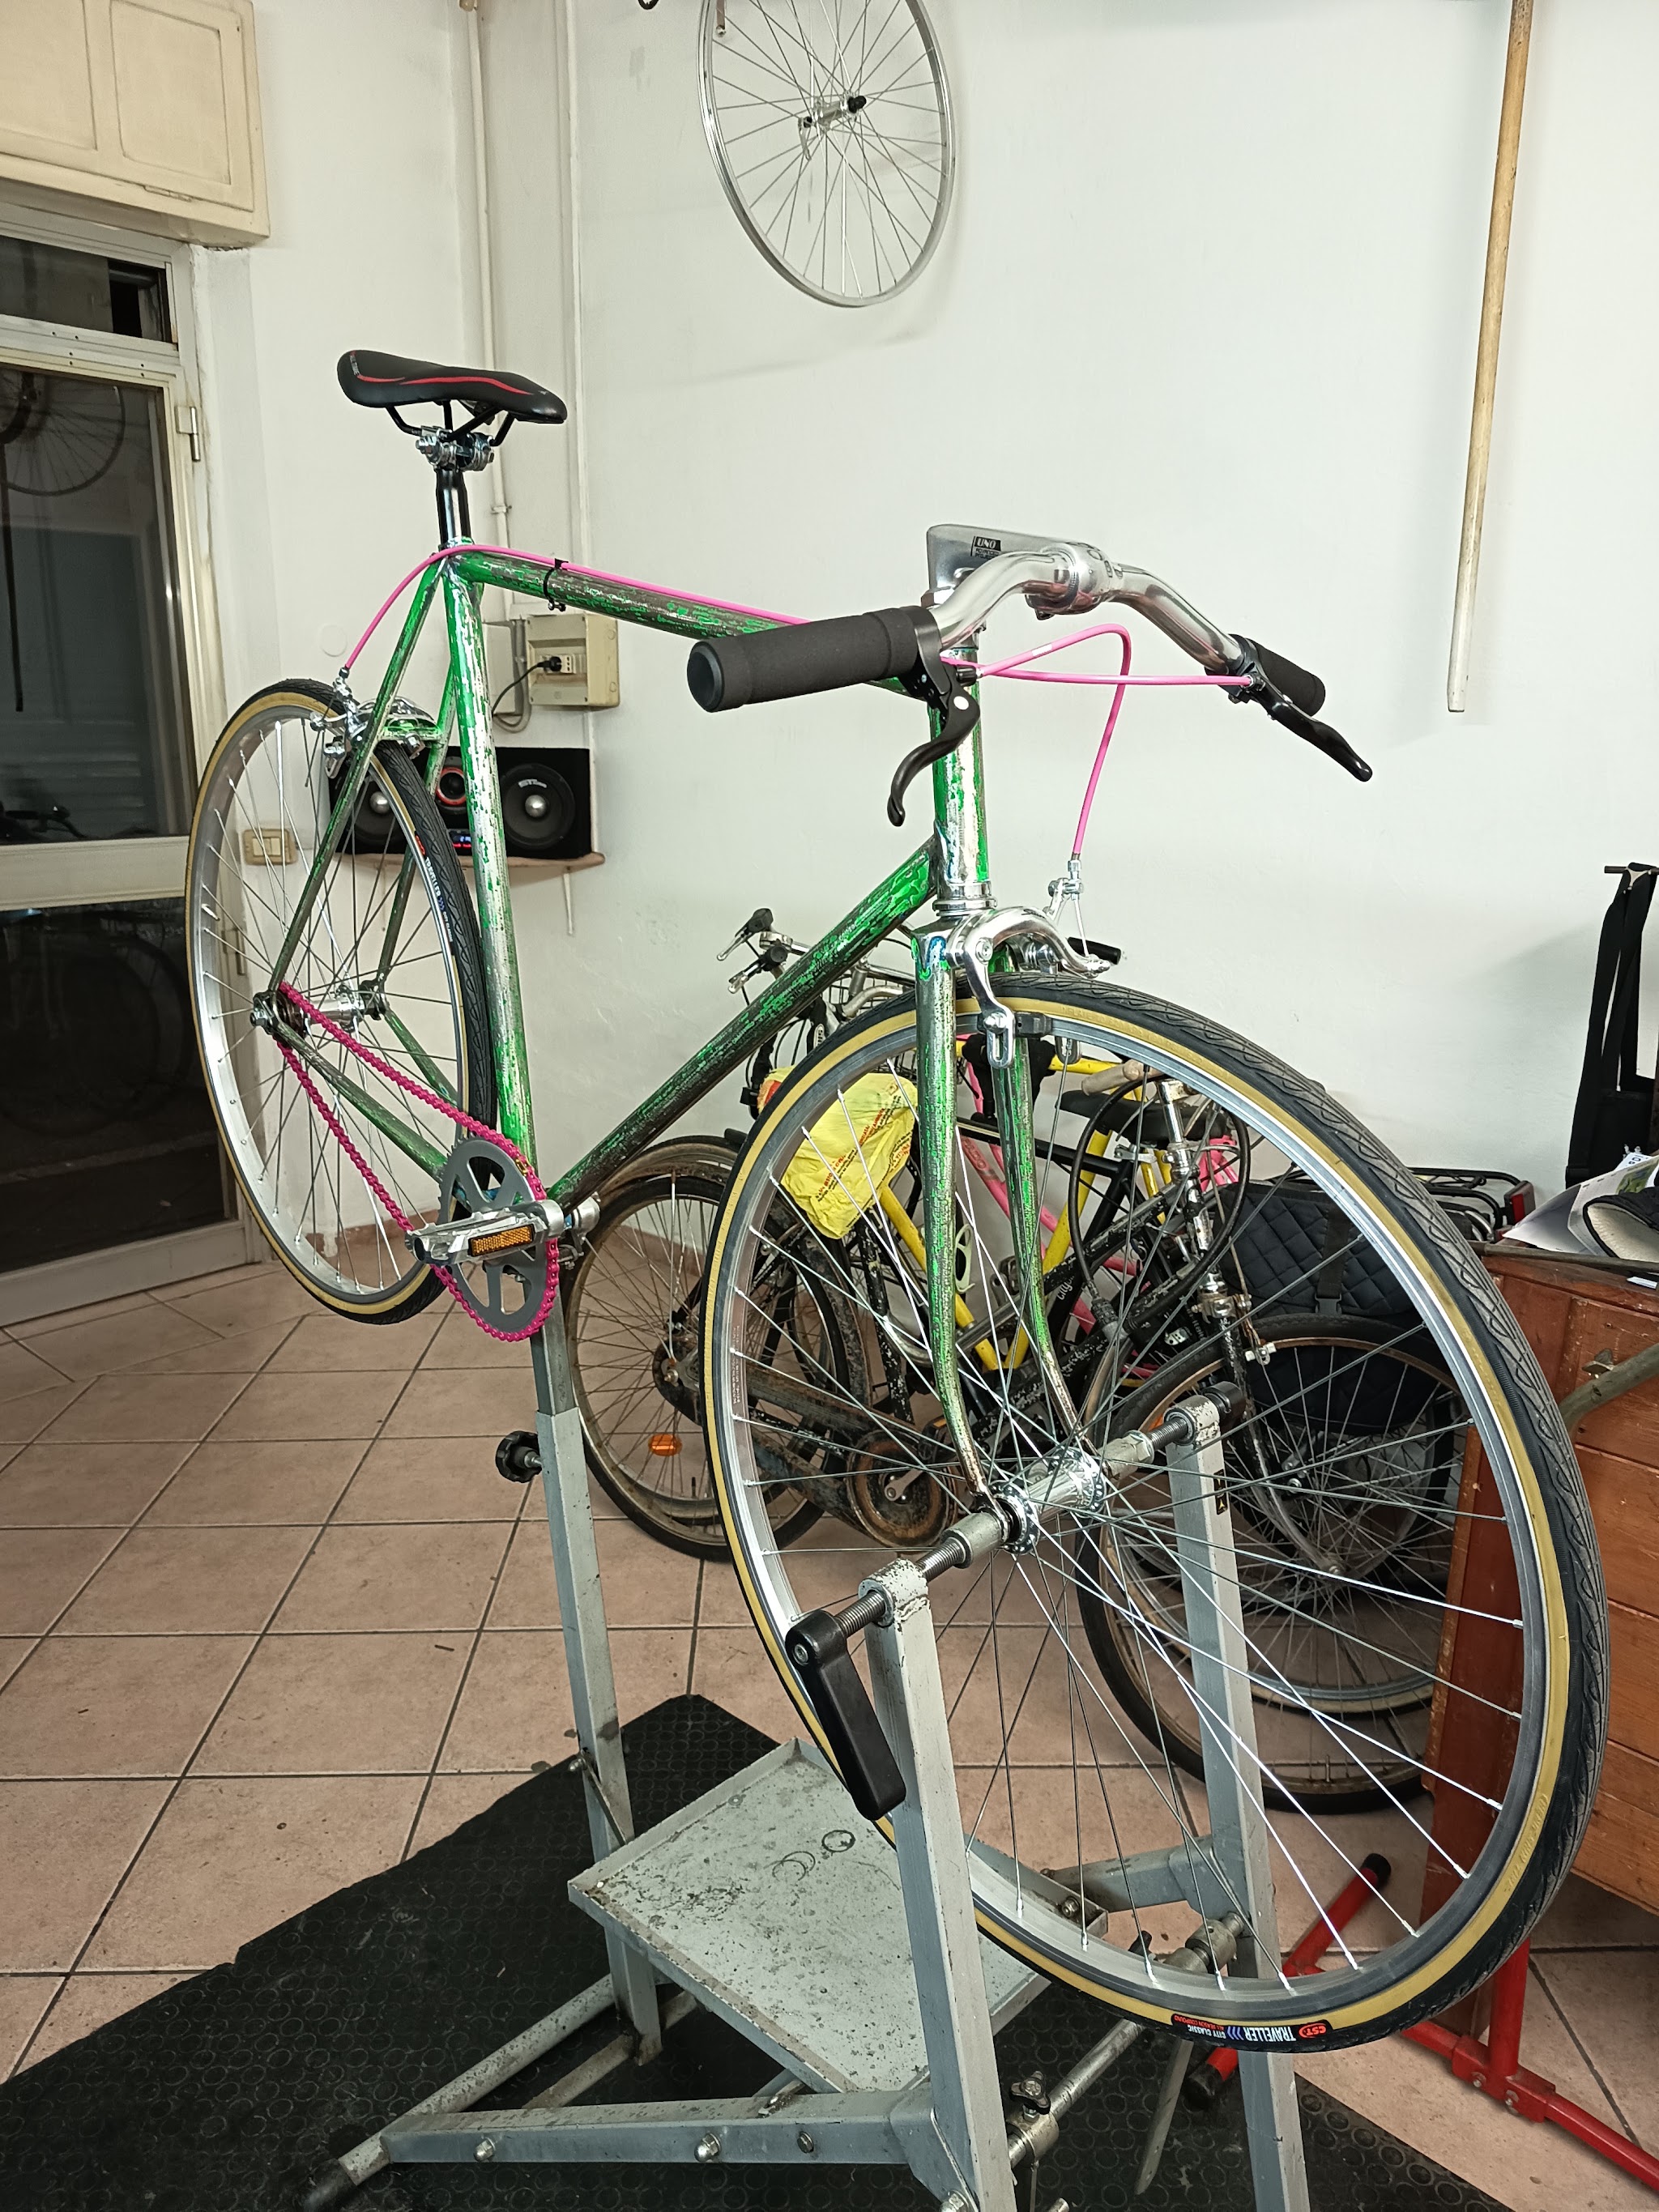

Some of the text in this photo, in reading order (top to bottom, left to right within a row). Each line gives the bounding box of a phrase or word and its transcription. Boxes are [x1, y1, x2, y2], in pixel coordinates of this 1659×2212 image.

[977, 538, 997, 549] UNO
[425, 857, 441, 897] TRAVELLER
[1174, 2015, 1198, 2026] COMPOUND
[1198, 2021, 1216, 2030] SEASON
[1187, 2023, 1328, 2042] CST TRAVELLER CITY CLASSIC
